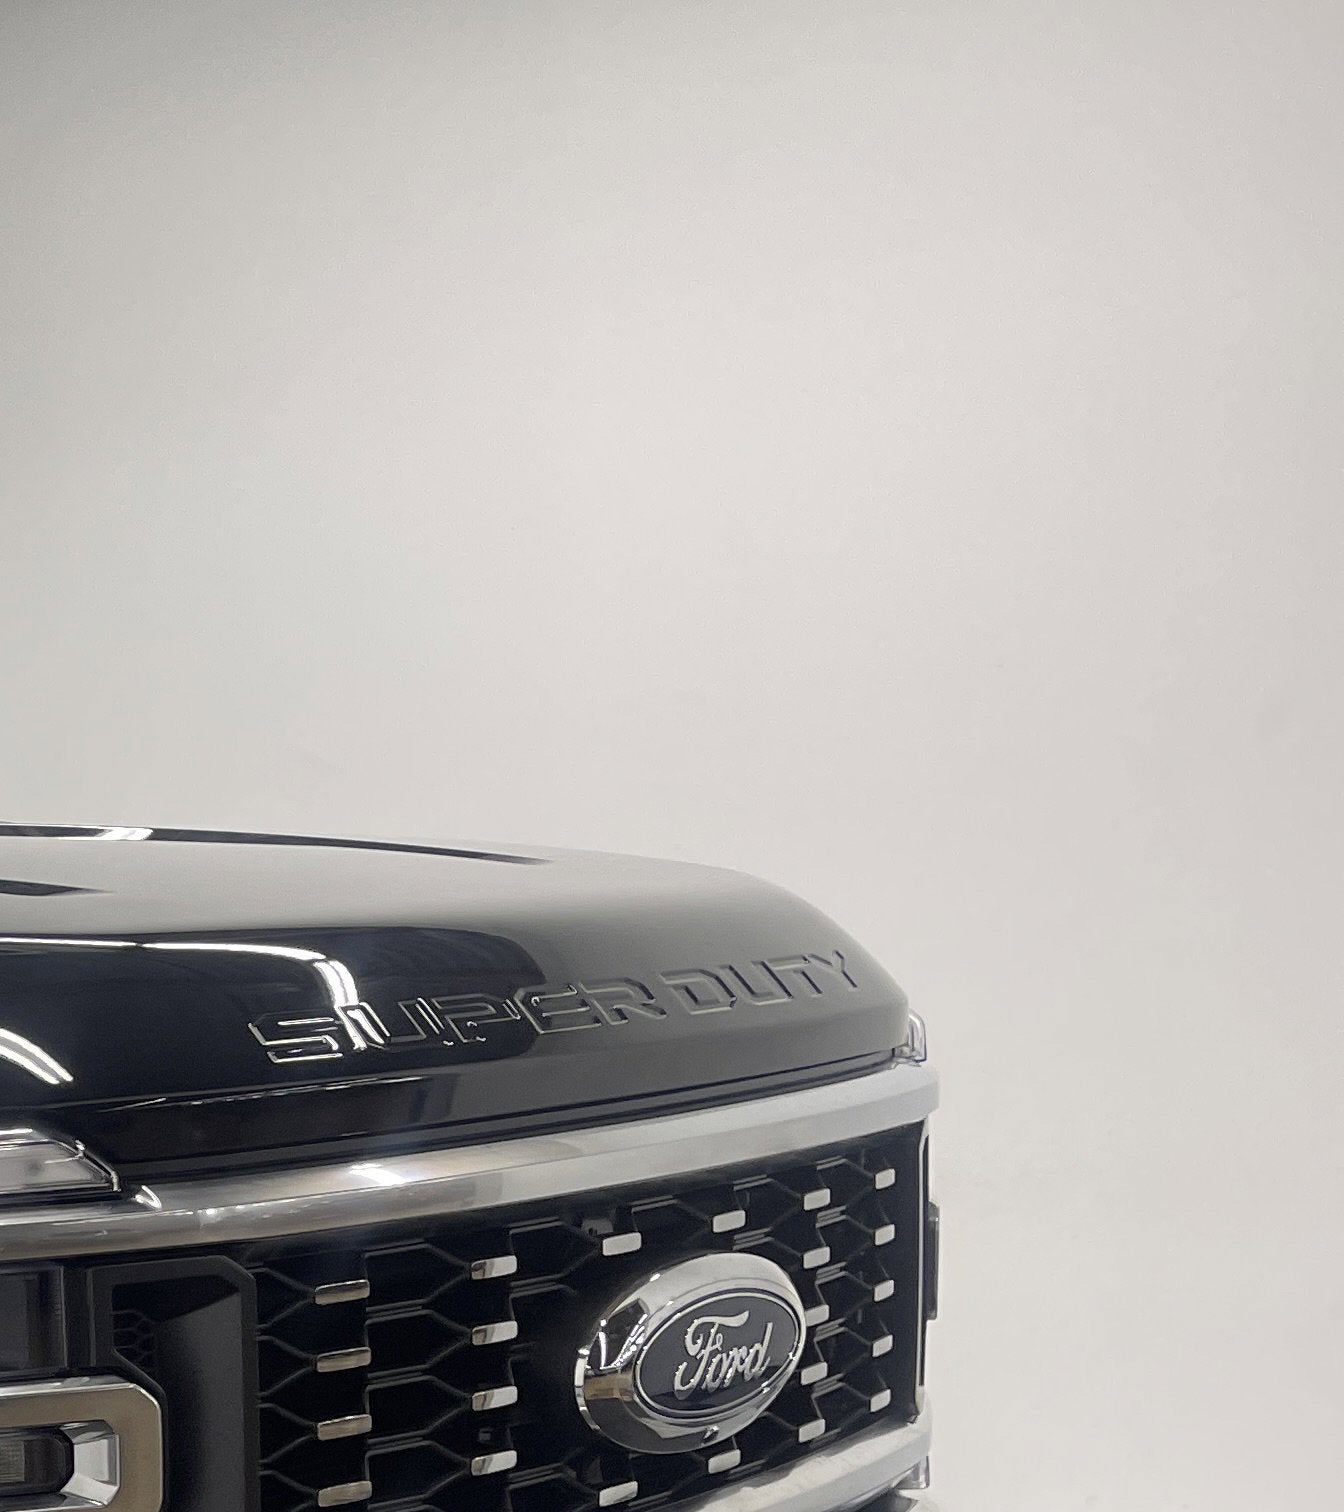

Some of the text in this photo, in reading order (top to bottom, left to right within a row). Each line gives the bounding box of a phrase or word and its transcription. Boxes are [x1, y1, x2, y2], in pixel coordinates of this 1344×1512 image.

[248, 948, 860, 1063] SUPER DUTY
[673, 1309, 775, 1401] Ford
